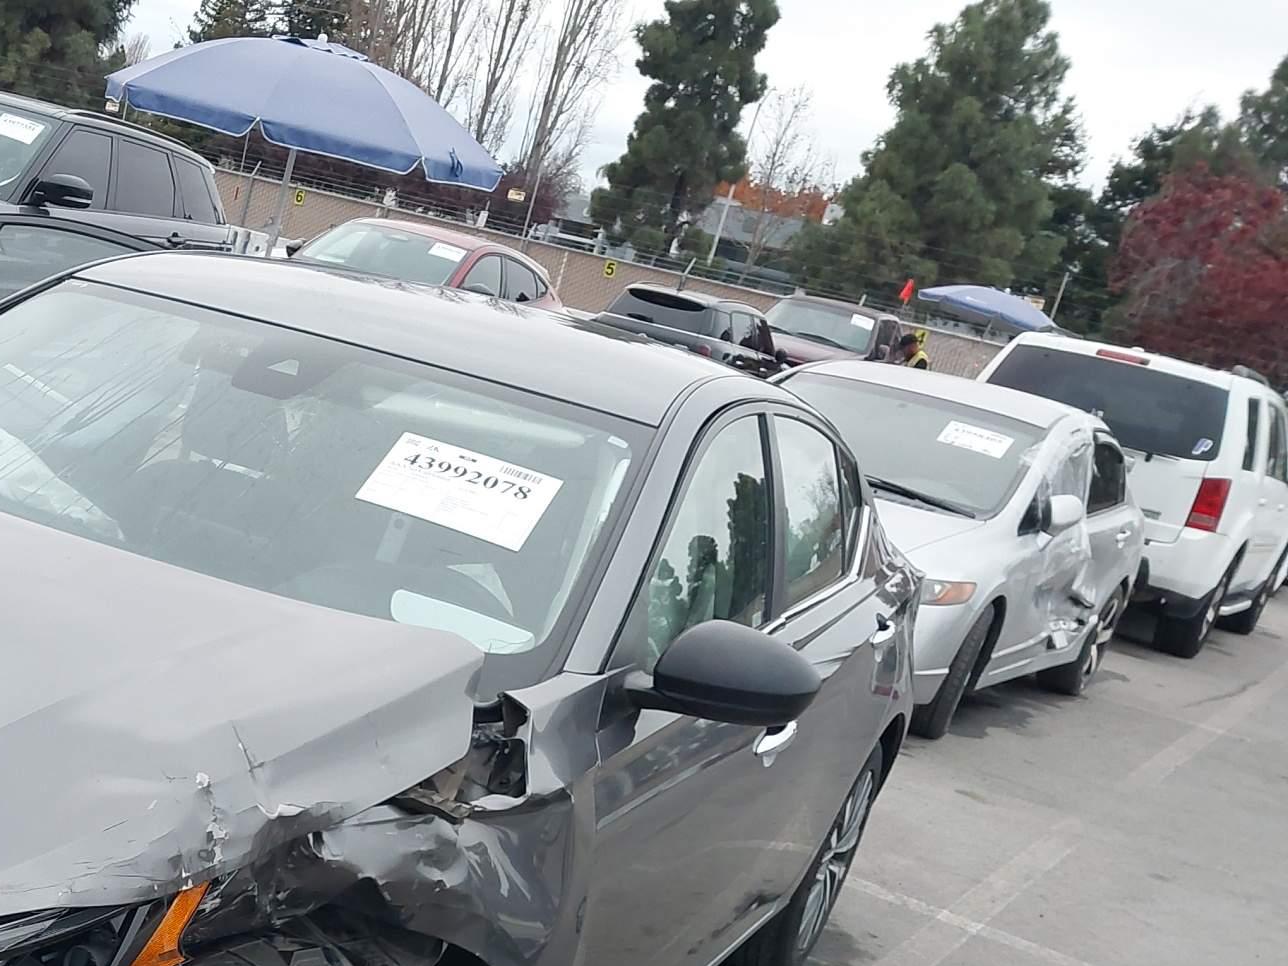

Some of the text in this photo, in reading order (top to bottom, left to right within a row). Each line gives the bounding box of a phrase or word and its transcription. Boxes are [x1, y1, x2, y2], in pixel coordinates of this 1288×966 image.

[295, 190, 303, 203] 6
[605, 262, 616, 276] 5
[403, 452, 533, 501] 43992078
